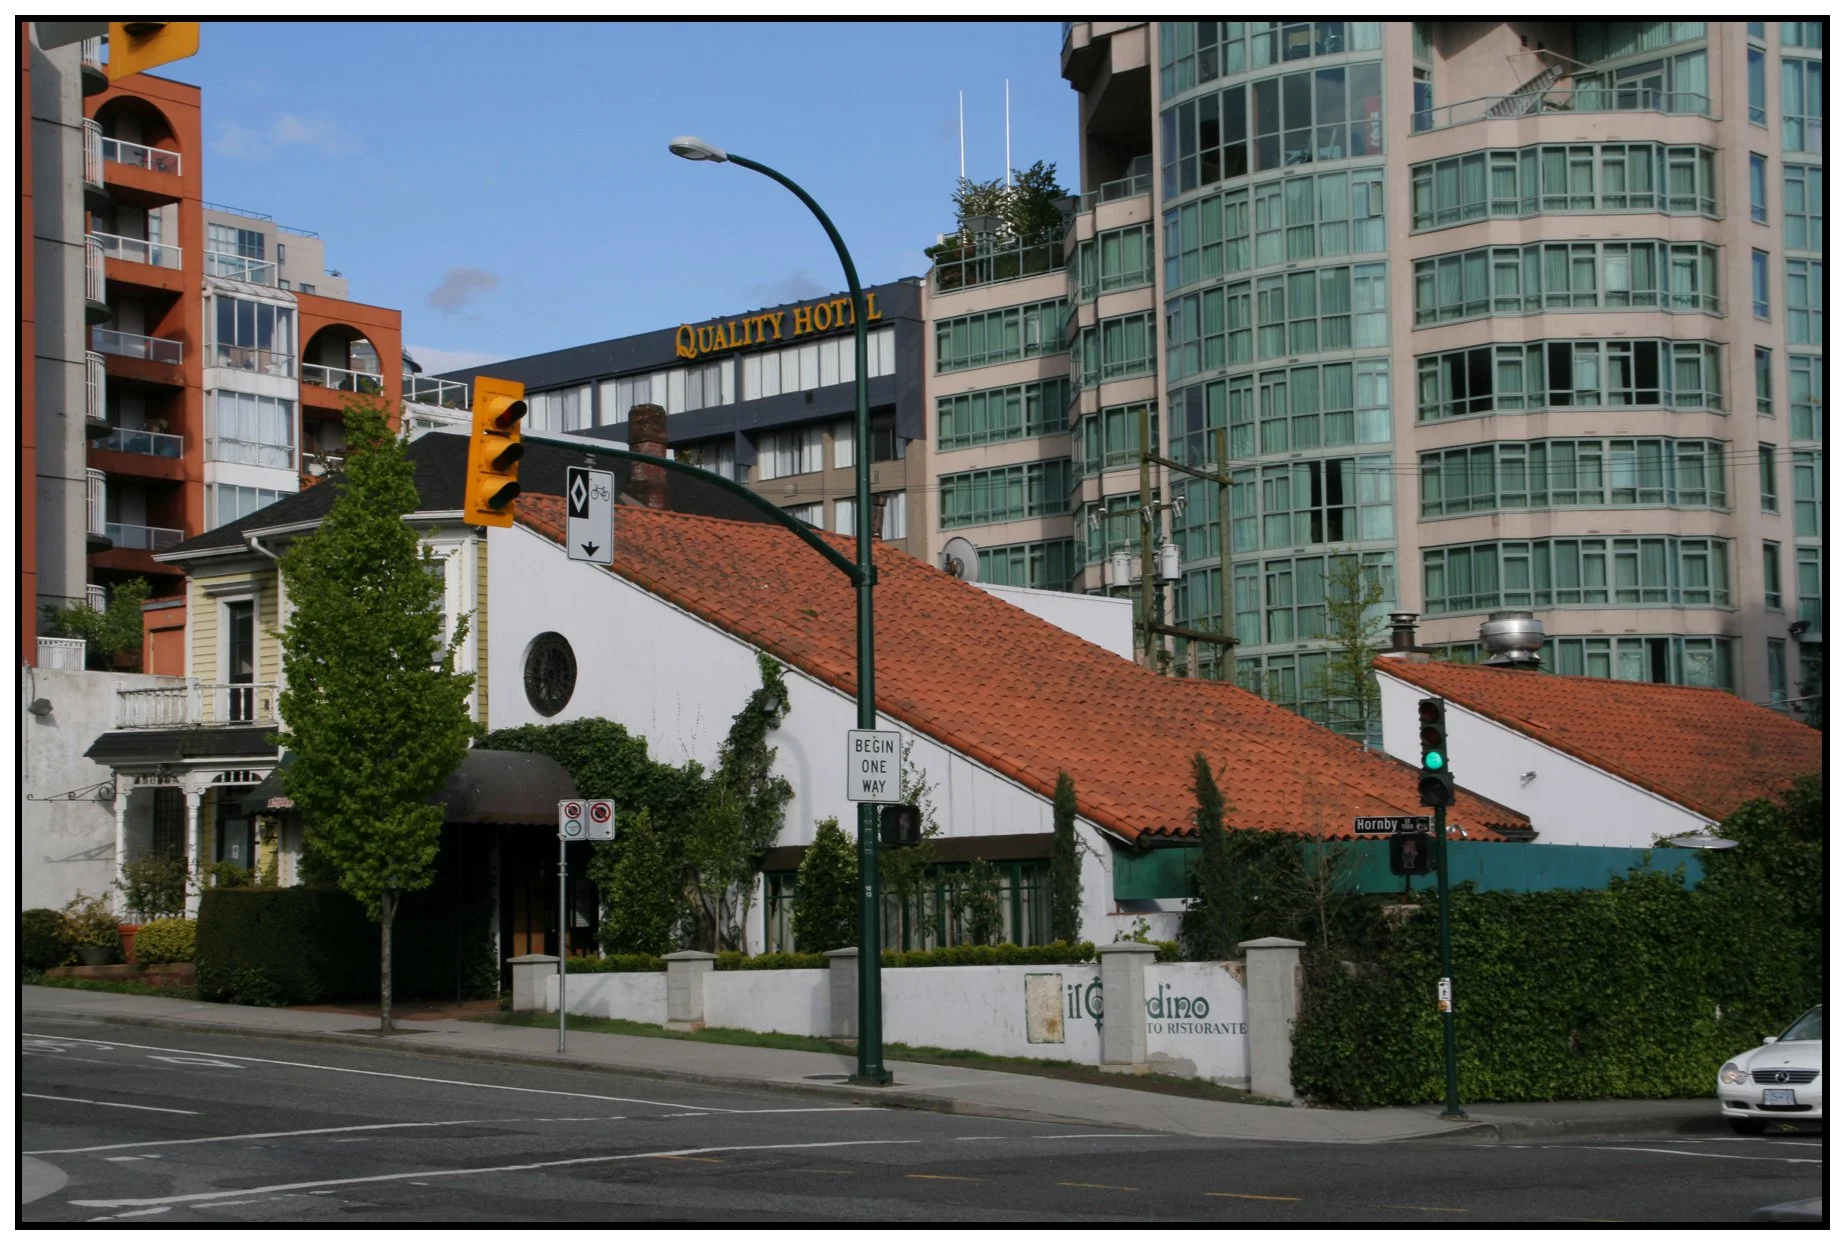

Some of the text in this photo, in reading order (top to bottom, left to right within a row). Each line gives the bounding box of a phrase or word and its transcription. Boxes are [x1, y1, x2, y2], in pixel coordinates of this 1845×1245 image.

[675, 294, 784, 359] QUALITY
[855, 739, 894, 754] BEGIN
[862, 759, 887, 774] ONE
[862, 779, 886, 794] WAY
[1357, 817, 1398, 833] Hornby
[1167, 1022, 1248, 1035] RISTORANTE
